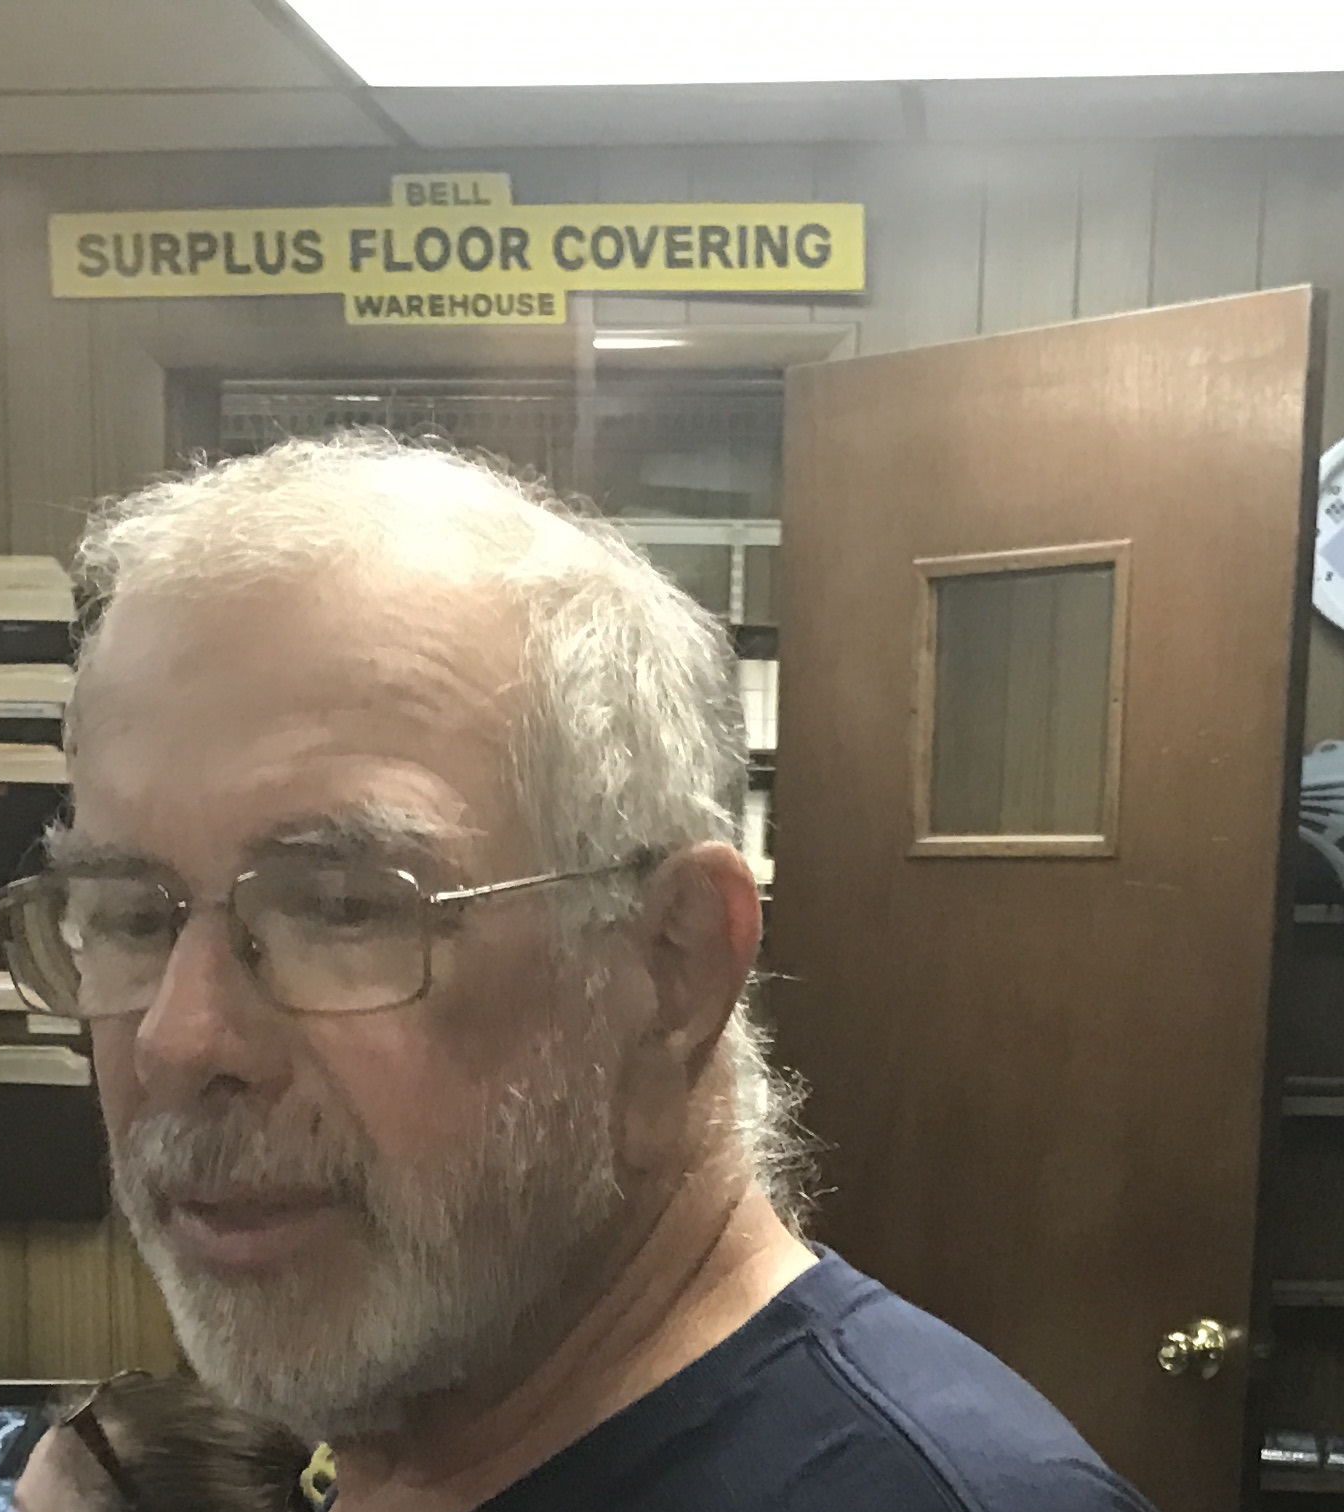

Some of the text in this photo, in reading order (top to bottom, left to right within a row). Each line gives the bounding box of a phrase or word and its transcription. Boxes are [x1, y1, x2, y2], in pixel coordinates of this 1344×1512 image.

[404, 180, 492, 208] BELL
[76, 222, 833, 278] SURPLUS FLOOR COVERING
[353, 292, 556, 319] WAREHOUSE
